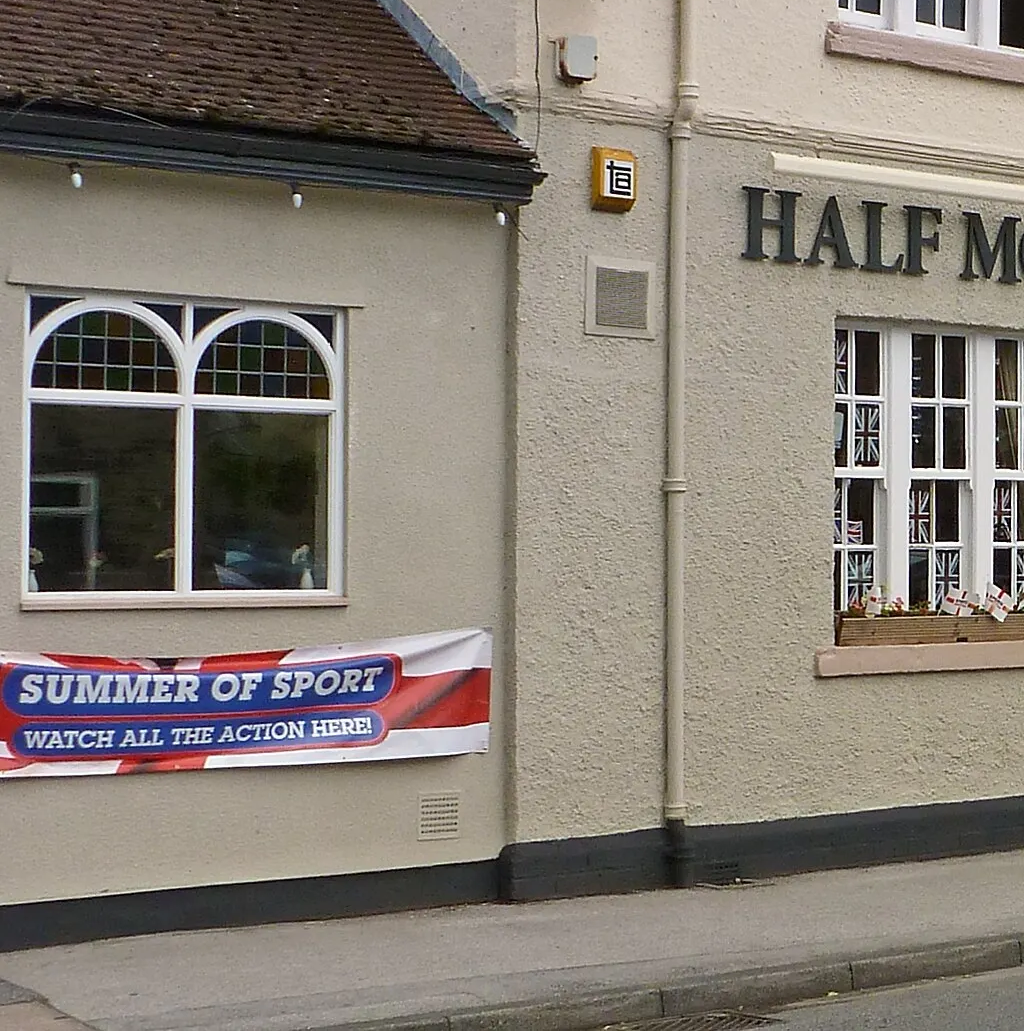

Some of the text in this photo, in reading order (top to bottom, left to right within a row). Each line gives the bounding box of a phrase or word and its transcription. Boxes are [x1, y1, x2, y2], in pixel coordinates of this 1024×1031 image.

[740, 185, 943, 276] HALF
[19, 667, 384, 704] SUMMER OF SPORT
[24, 717, 373, 749] WATCH ALL THE ACTION HERE!
